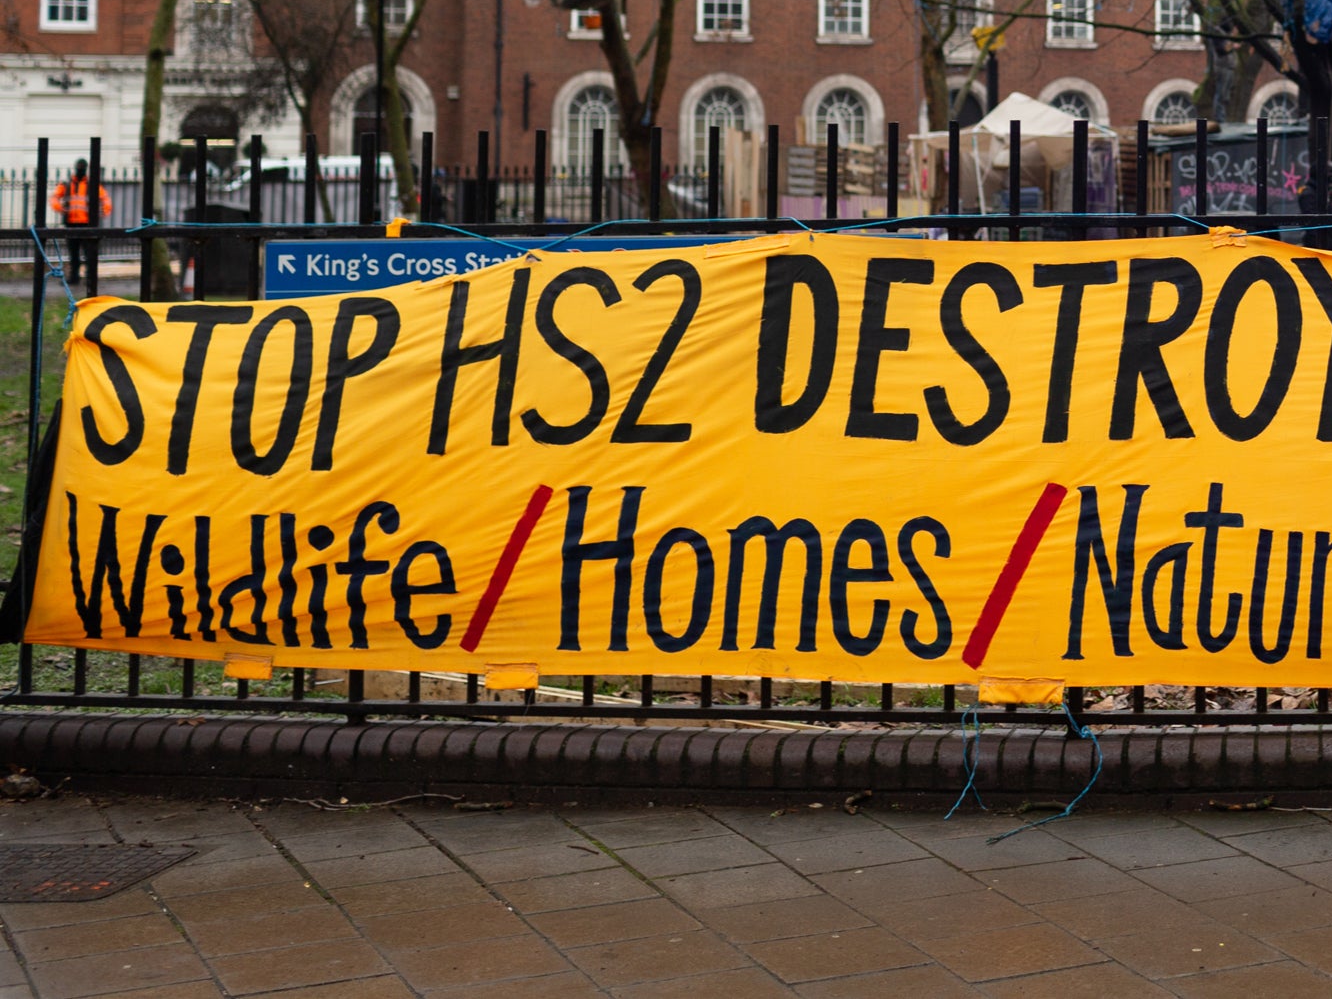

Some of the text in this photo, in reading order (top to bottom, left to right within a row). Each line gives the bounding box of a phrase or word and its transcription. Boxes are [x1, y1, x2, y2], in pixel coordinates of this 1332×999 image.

[306, 253, 380, 281] King's
[387, 253, 457, 275] Cross
[82, 298, 401, 476] STOP
[427, 258, 702, 456] HS2
